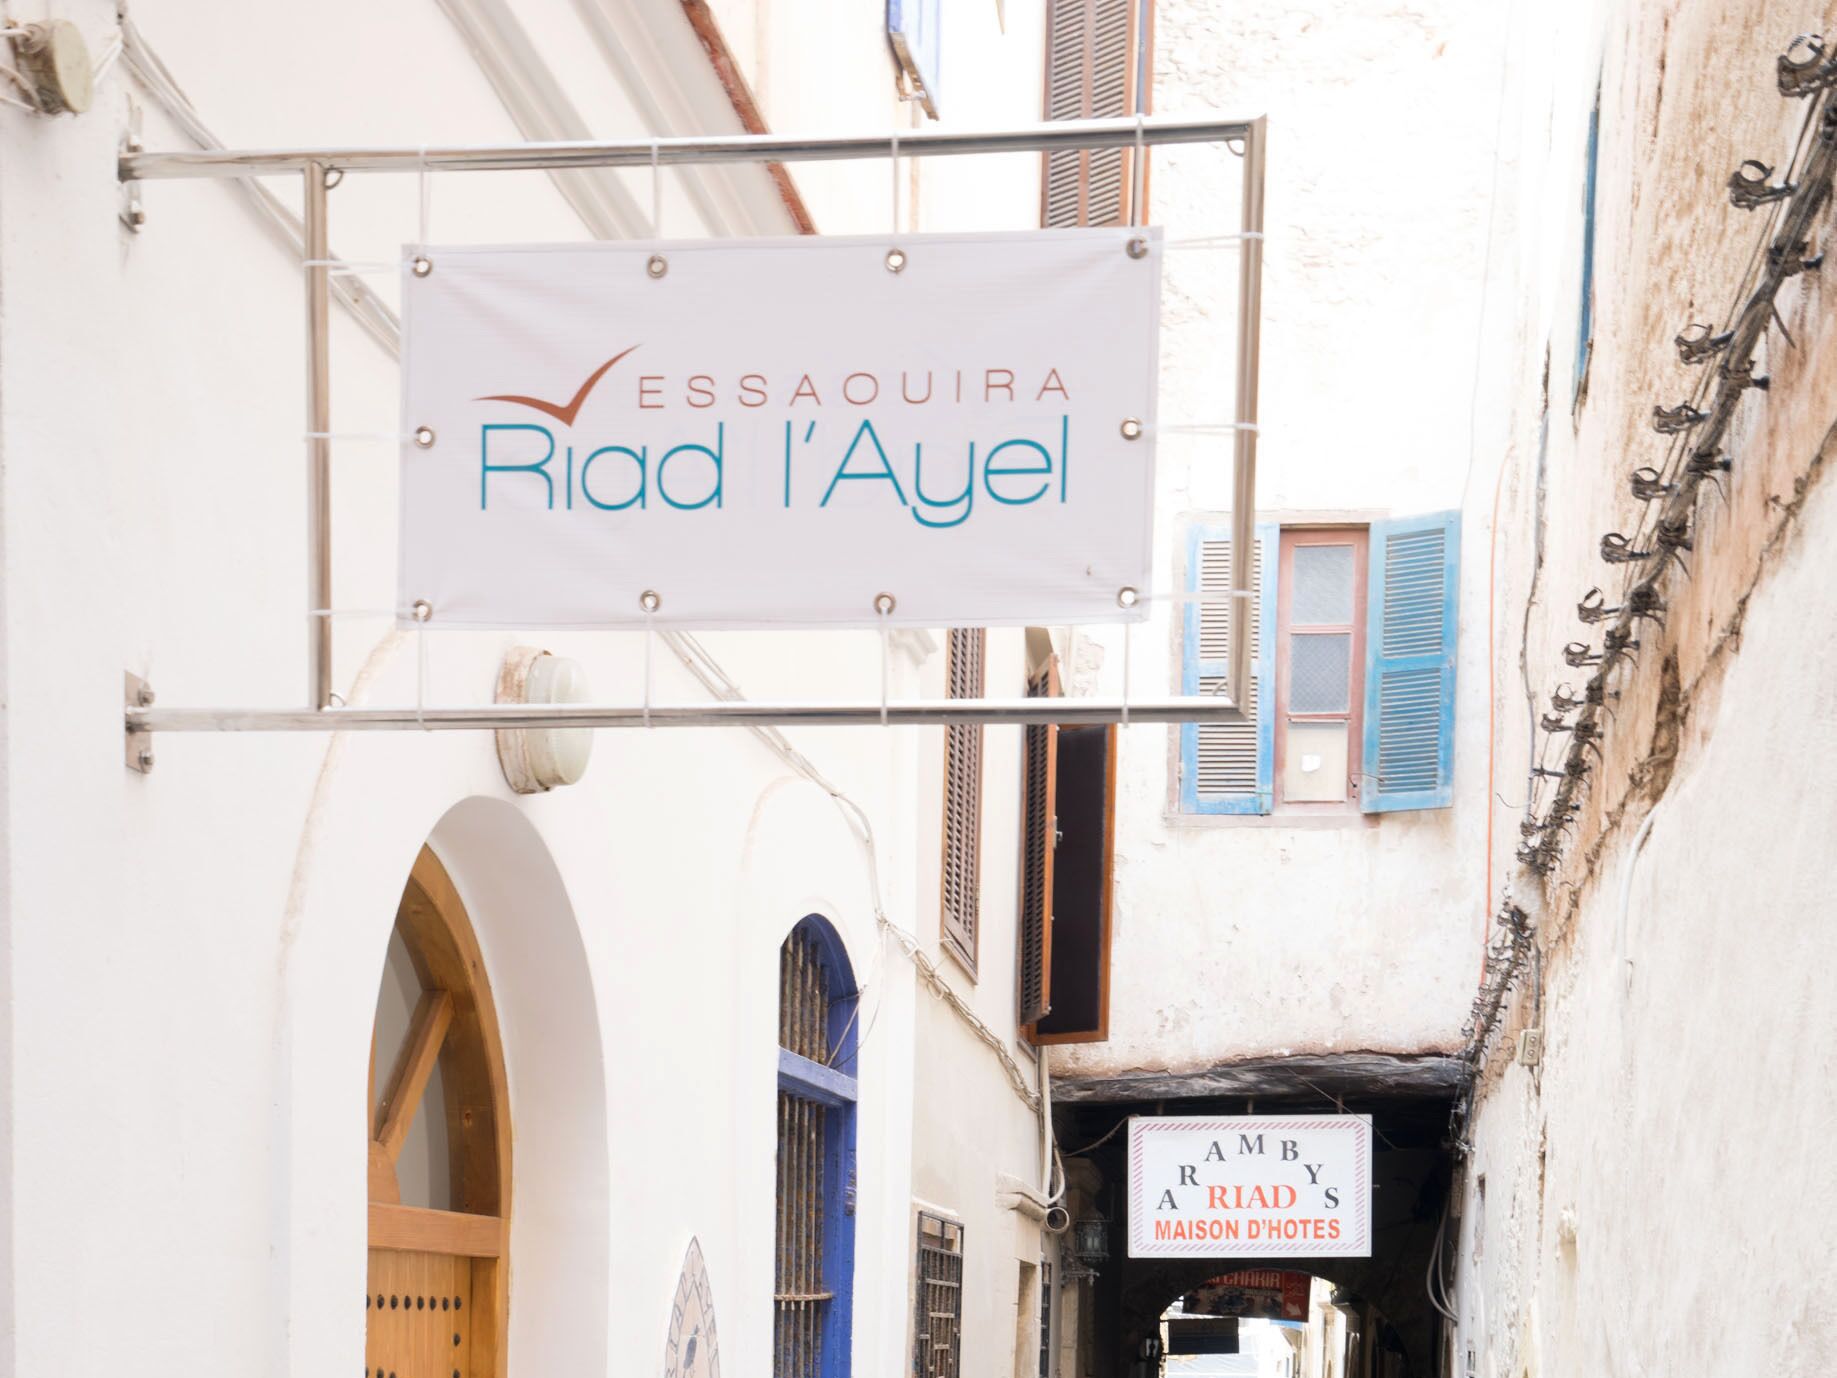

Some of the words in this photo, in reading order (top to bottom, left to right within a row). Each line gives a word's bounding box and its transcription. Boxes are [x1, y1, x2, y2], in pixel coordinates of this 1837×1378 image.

[639, 367, 1070, 409] ESSAOUIRA
[481, 421, 724, 511] Riad
[784, 414, 1070, 529] l'Ayel
[1206, 1184, 1297, 1210] RIAD
[1154, 1219, 1240, 1241] MAISON
[1247, 1218, 1341, 1240] D'HOTES
